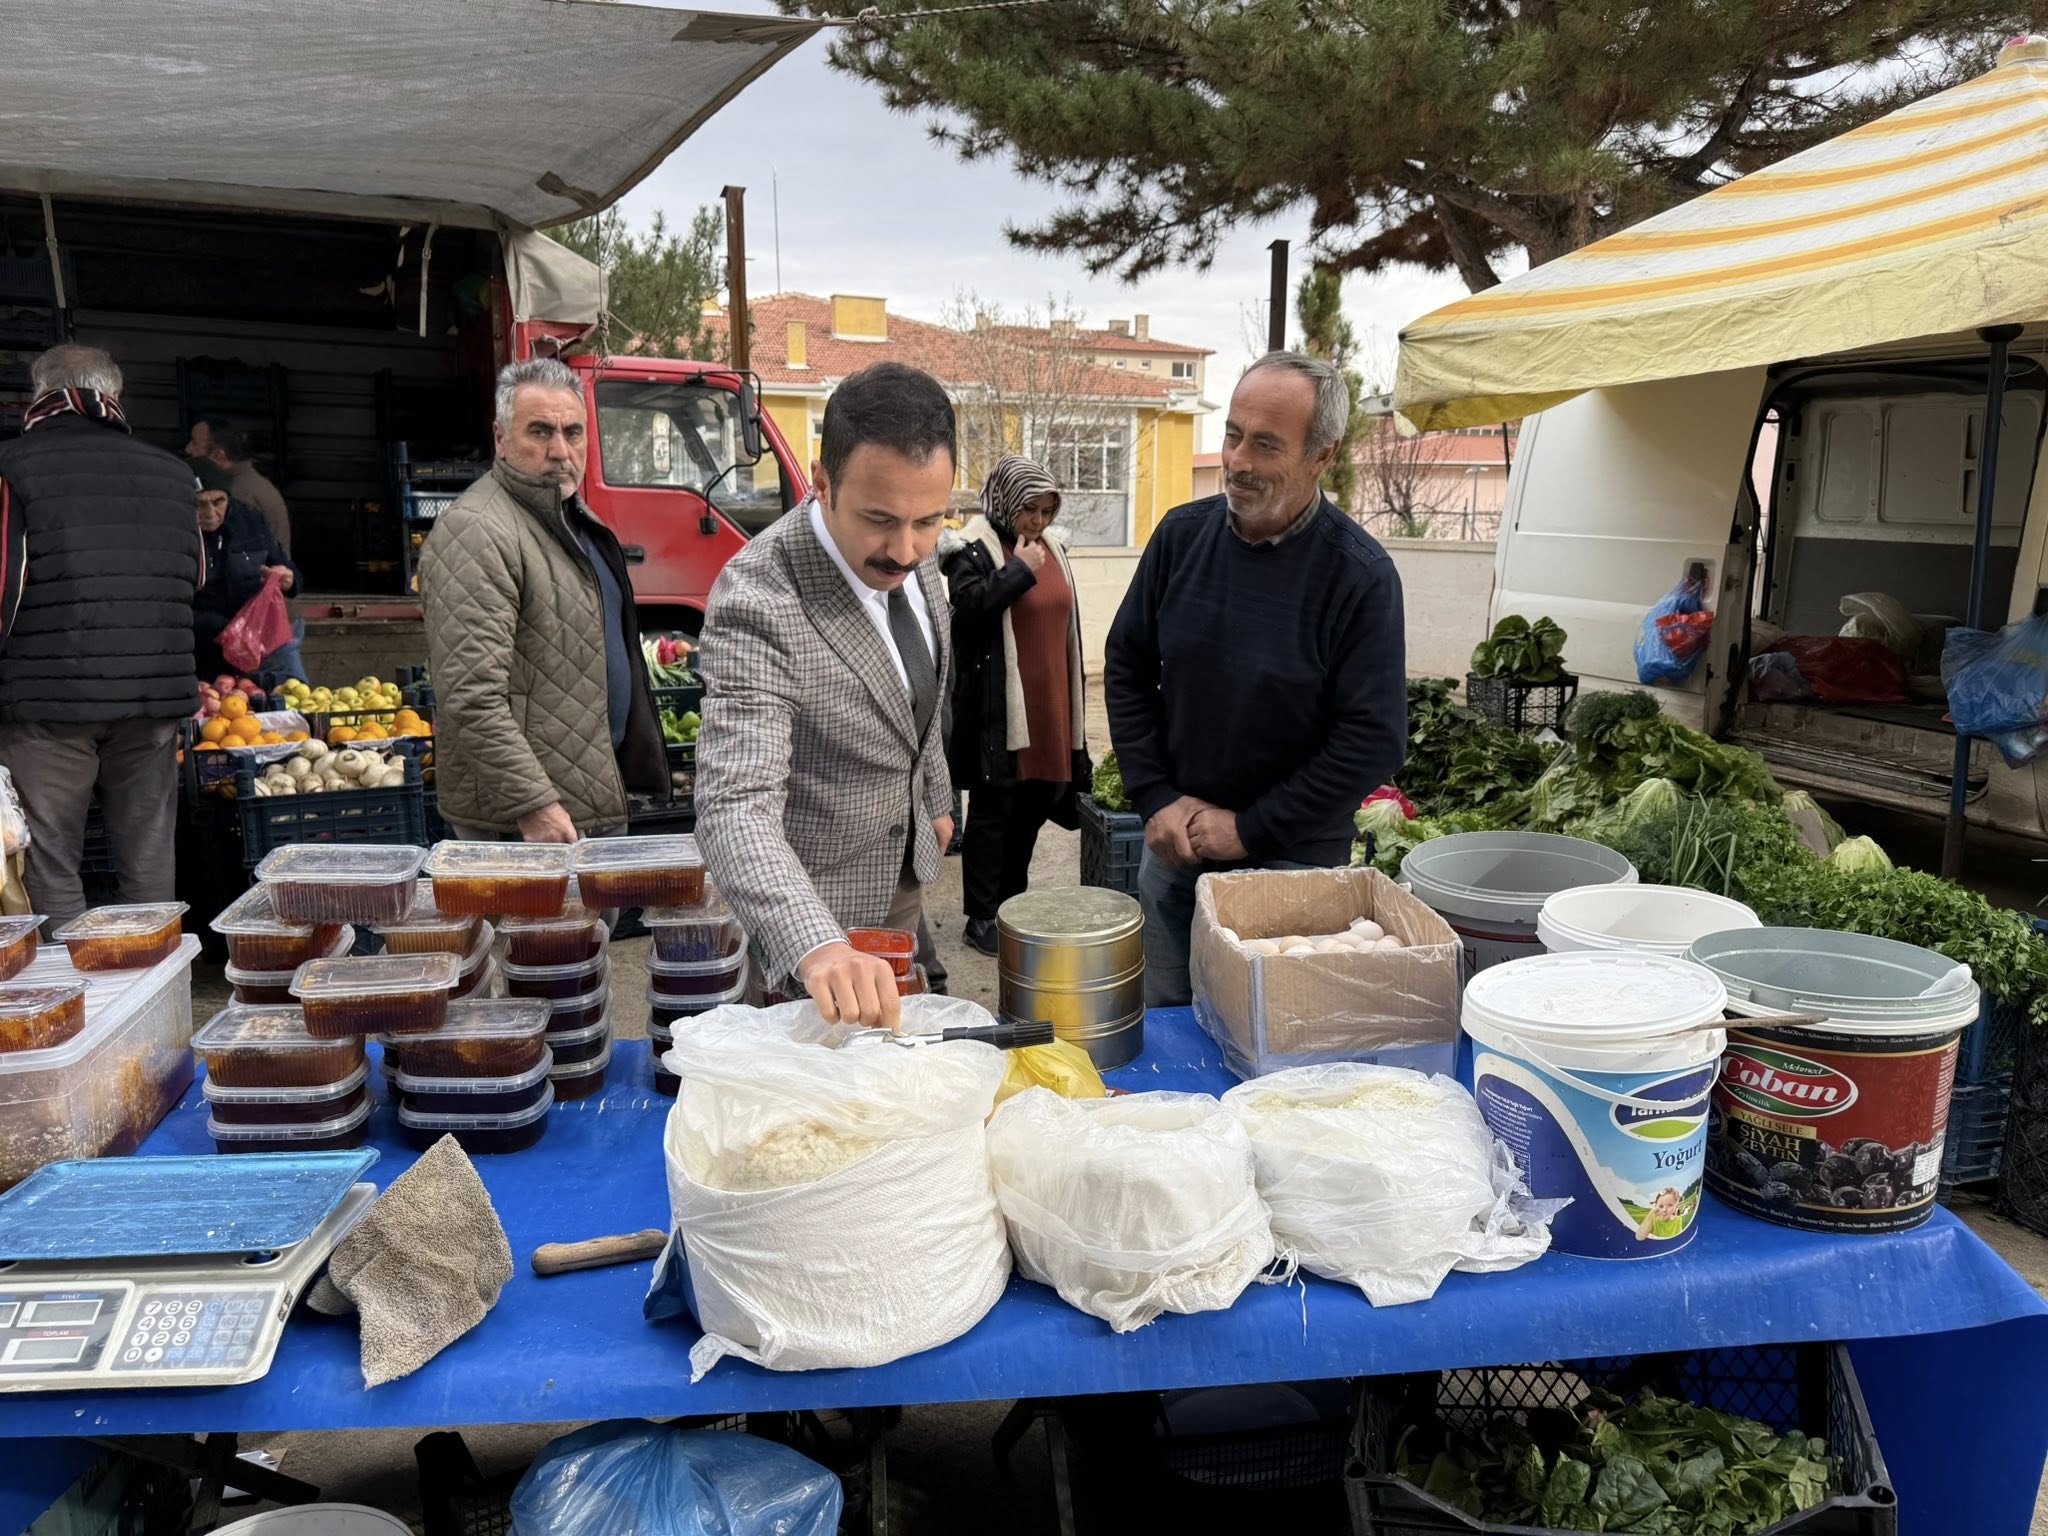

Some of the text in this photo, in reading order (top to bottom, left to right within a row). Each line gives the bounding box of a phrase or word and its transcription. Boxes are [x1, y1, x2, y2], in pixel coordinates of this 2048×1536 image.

[1782, 1062, 1823, 1075] Mehmed
[1733, 1086, 1771, 1109] Zeytincilik
[1775, 1123, 1803, 1135] SELE
[1652, 1139, 1703, 1170] Yoğurt
